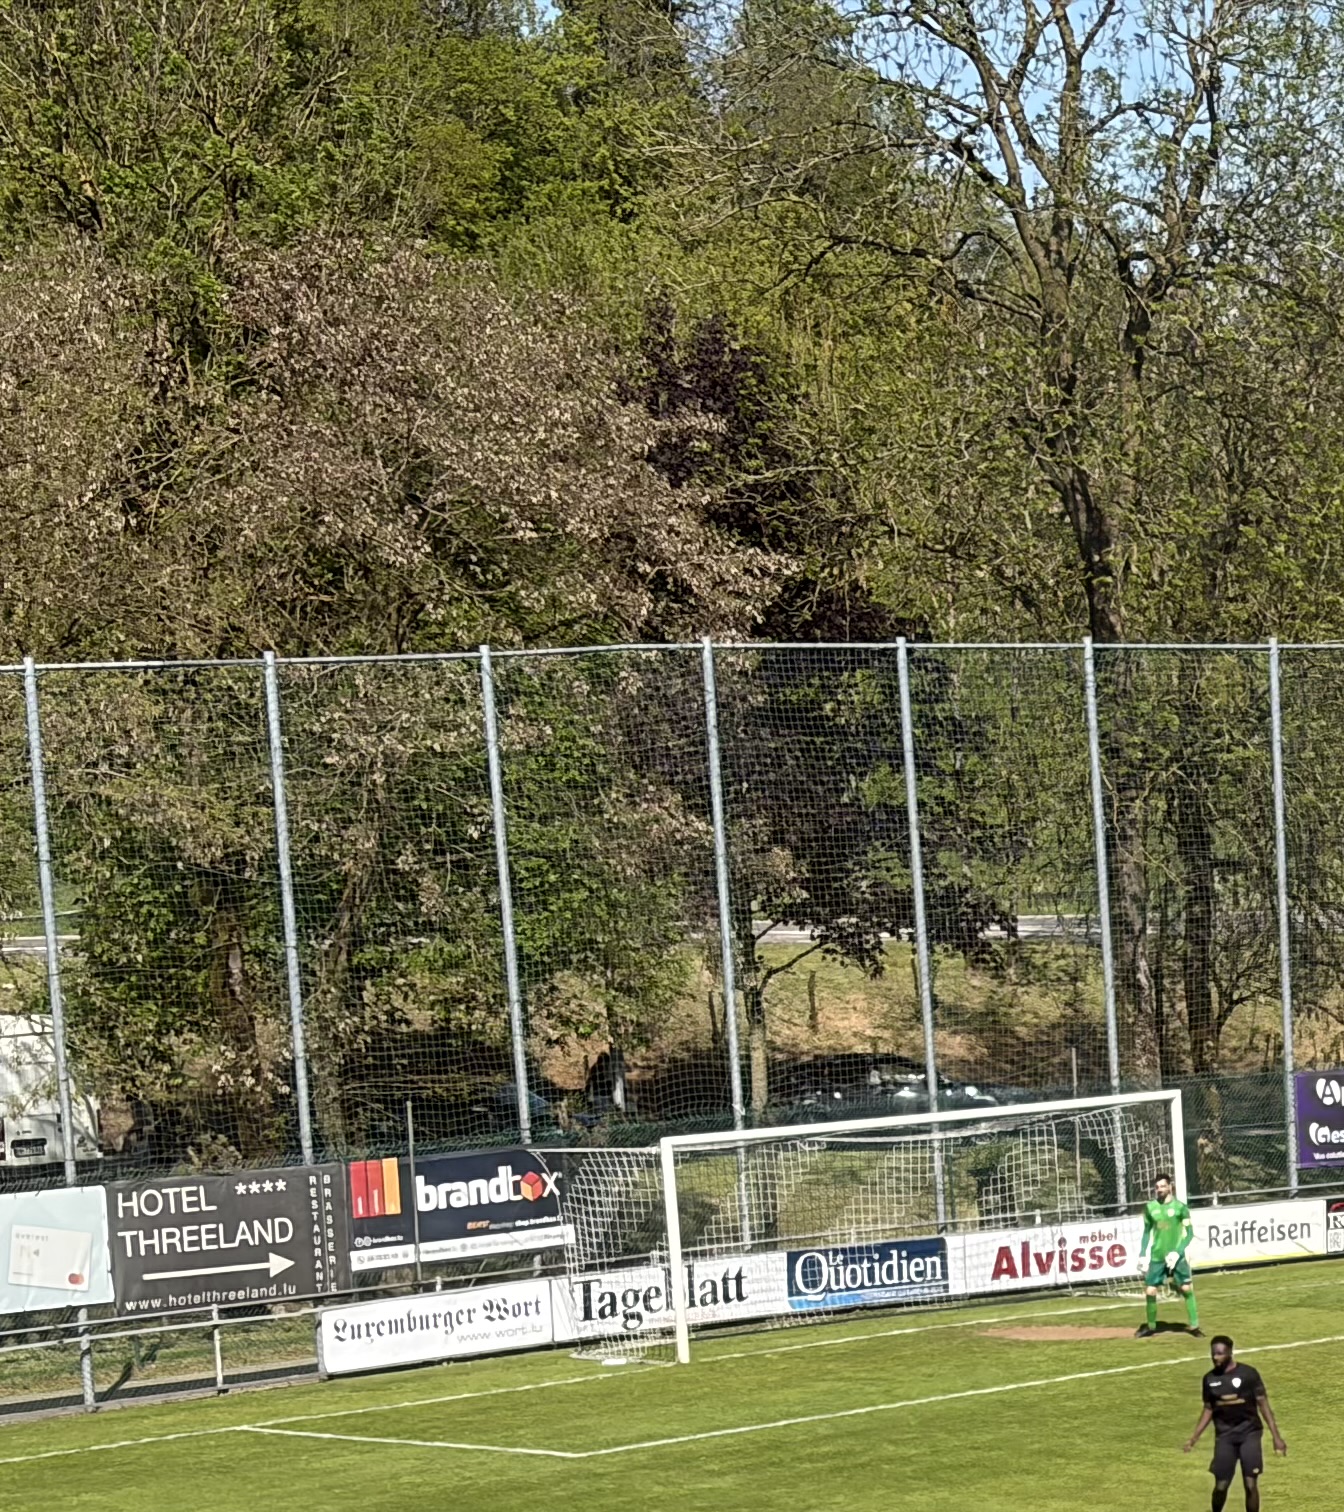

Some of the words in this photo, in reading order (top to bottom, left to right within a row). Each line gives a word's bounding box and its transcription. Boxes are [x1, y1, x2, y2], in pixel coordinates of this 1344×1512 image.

[118, 1185, 218, 1219] HOTEL
[118, 1217, 294, 1258] THREELAND
[309, 1175, 324, 1293] RESTAURANT
[323, 1174, 338, 1293] BRASSERIE
[1079, 1228, 1118, 1244] möbel
[1208, 1217, 1312, 1249] Raiffeisen
[795, 1249, 943, 1301] Quotidien
[828, 1251, 844, 1266] Le
[991, 1236, 1128, 1281] Alvisse
[125, 1283, 297, 1311] www.hotelthreeland.lu
[333, 1308, 477, 1343] Luxemburger
[482, 1295, 542, 1321] Wort
